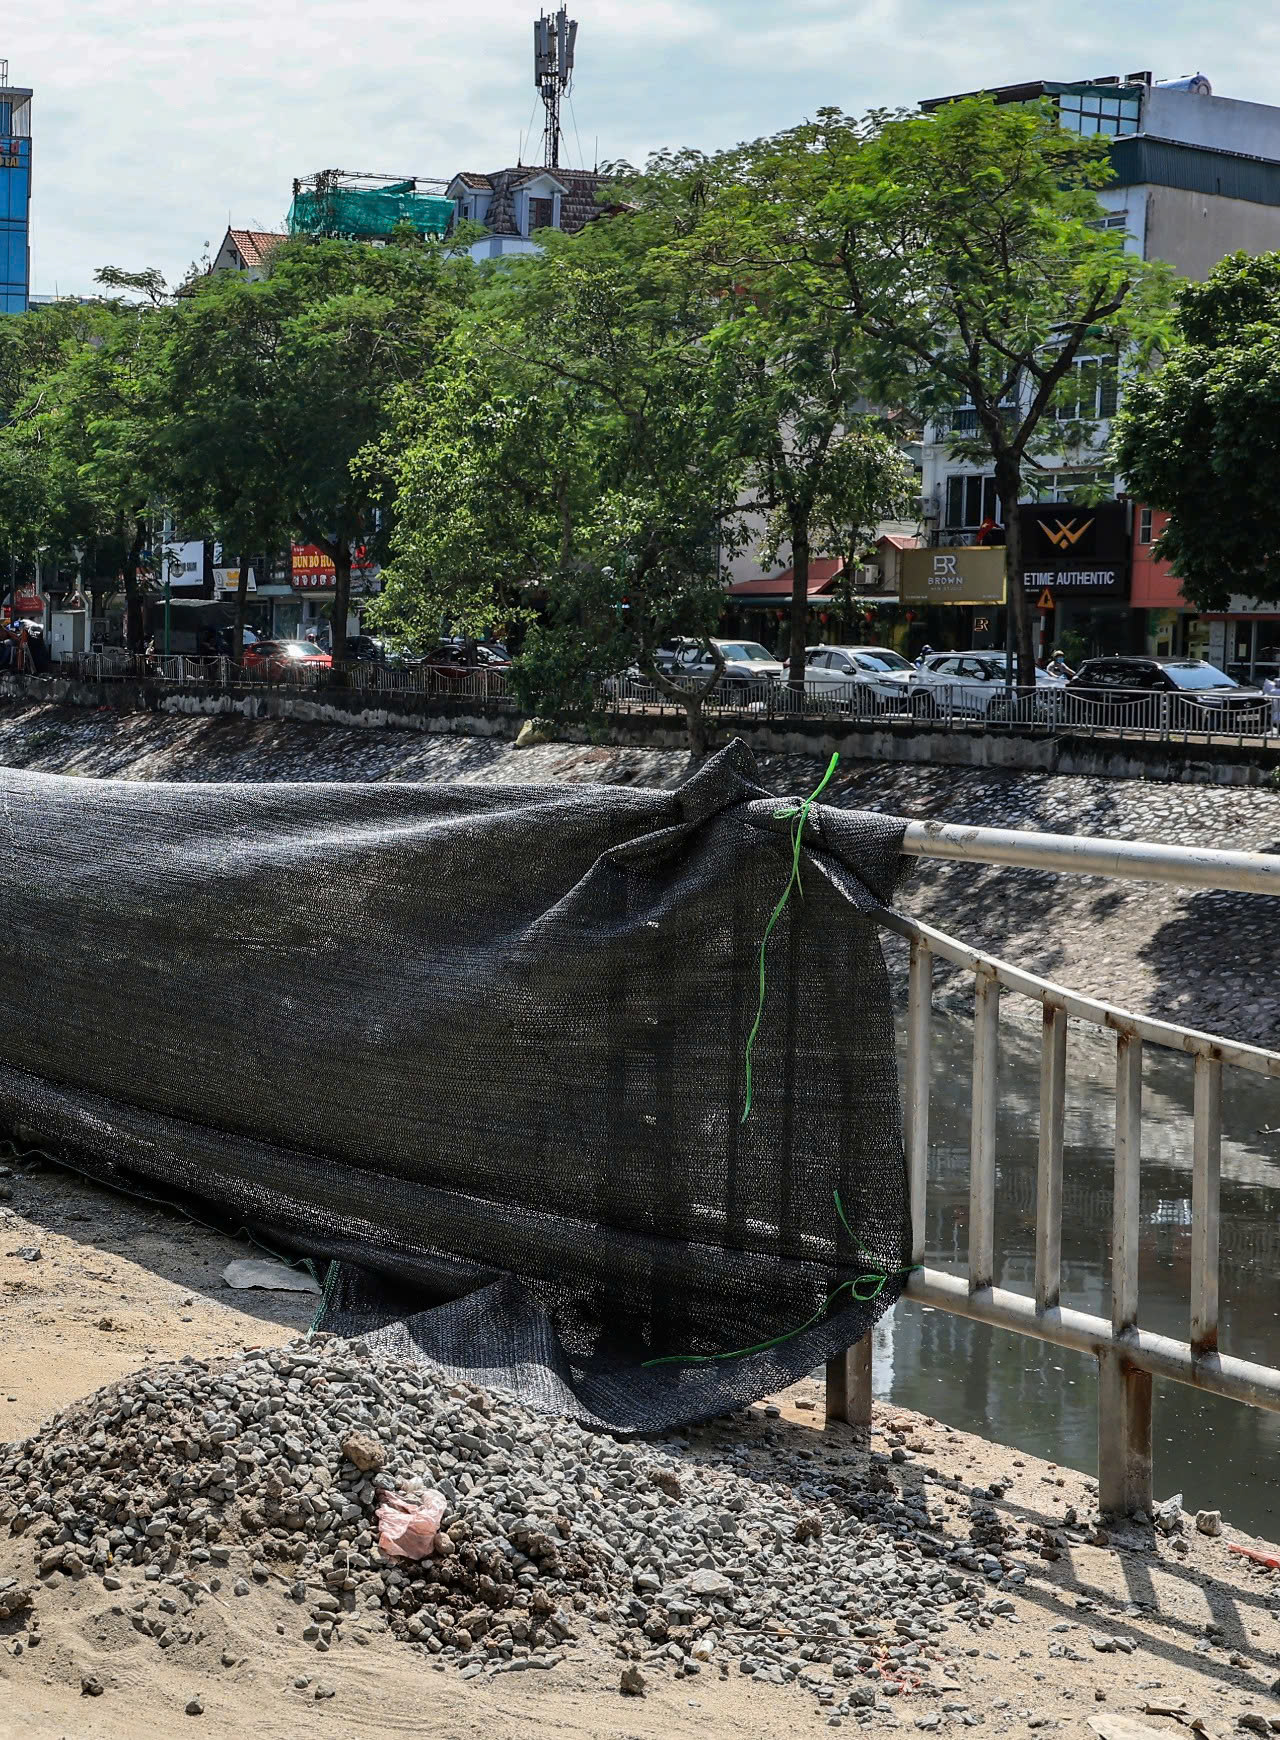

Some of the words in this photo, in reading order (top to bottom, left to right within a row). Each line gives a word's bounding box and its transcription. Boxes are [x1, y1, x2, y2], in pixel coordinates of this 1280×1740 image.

[292, 552, 308, 568] BÚN
[927, 577, 963, 585] BROWN
[1056, 571, 1115, 585] AUTHENTIC
